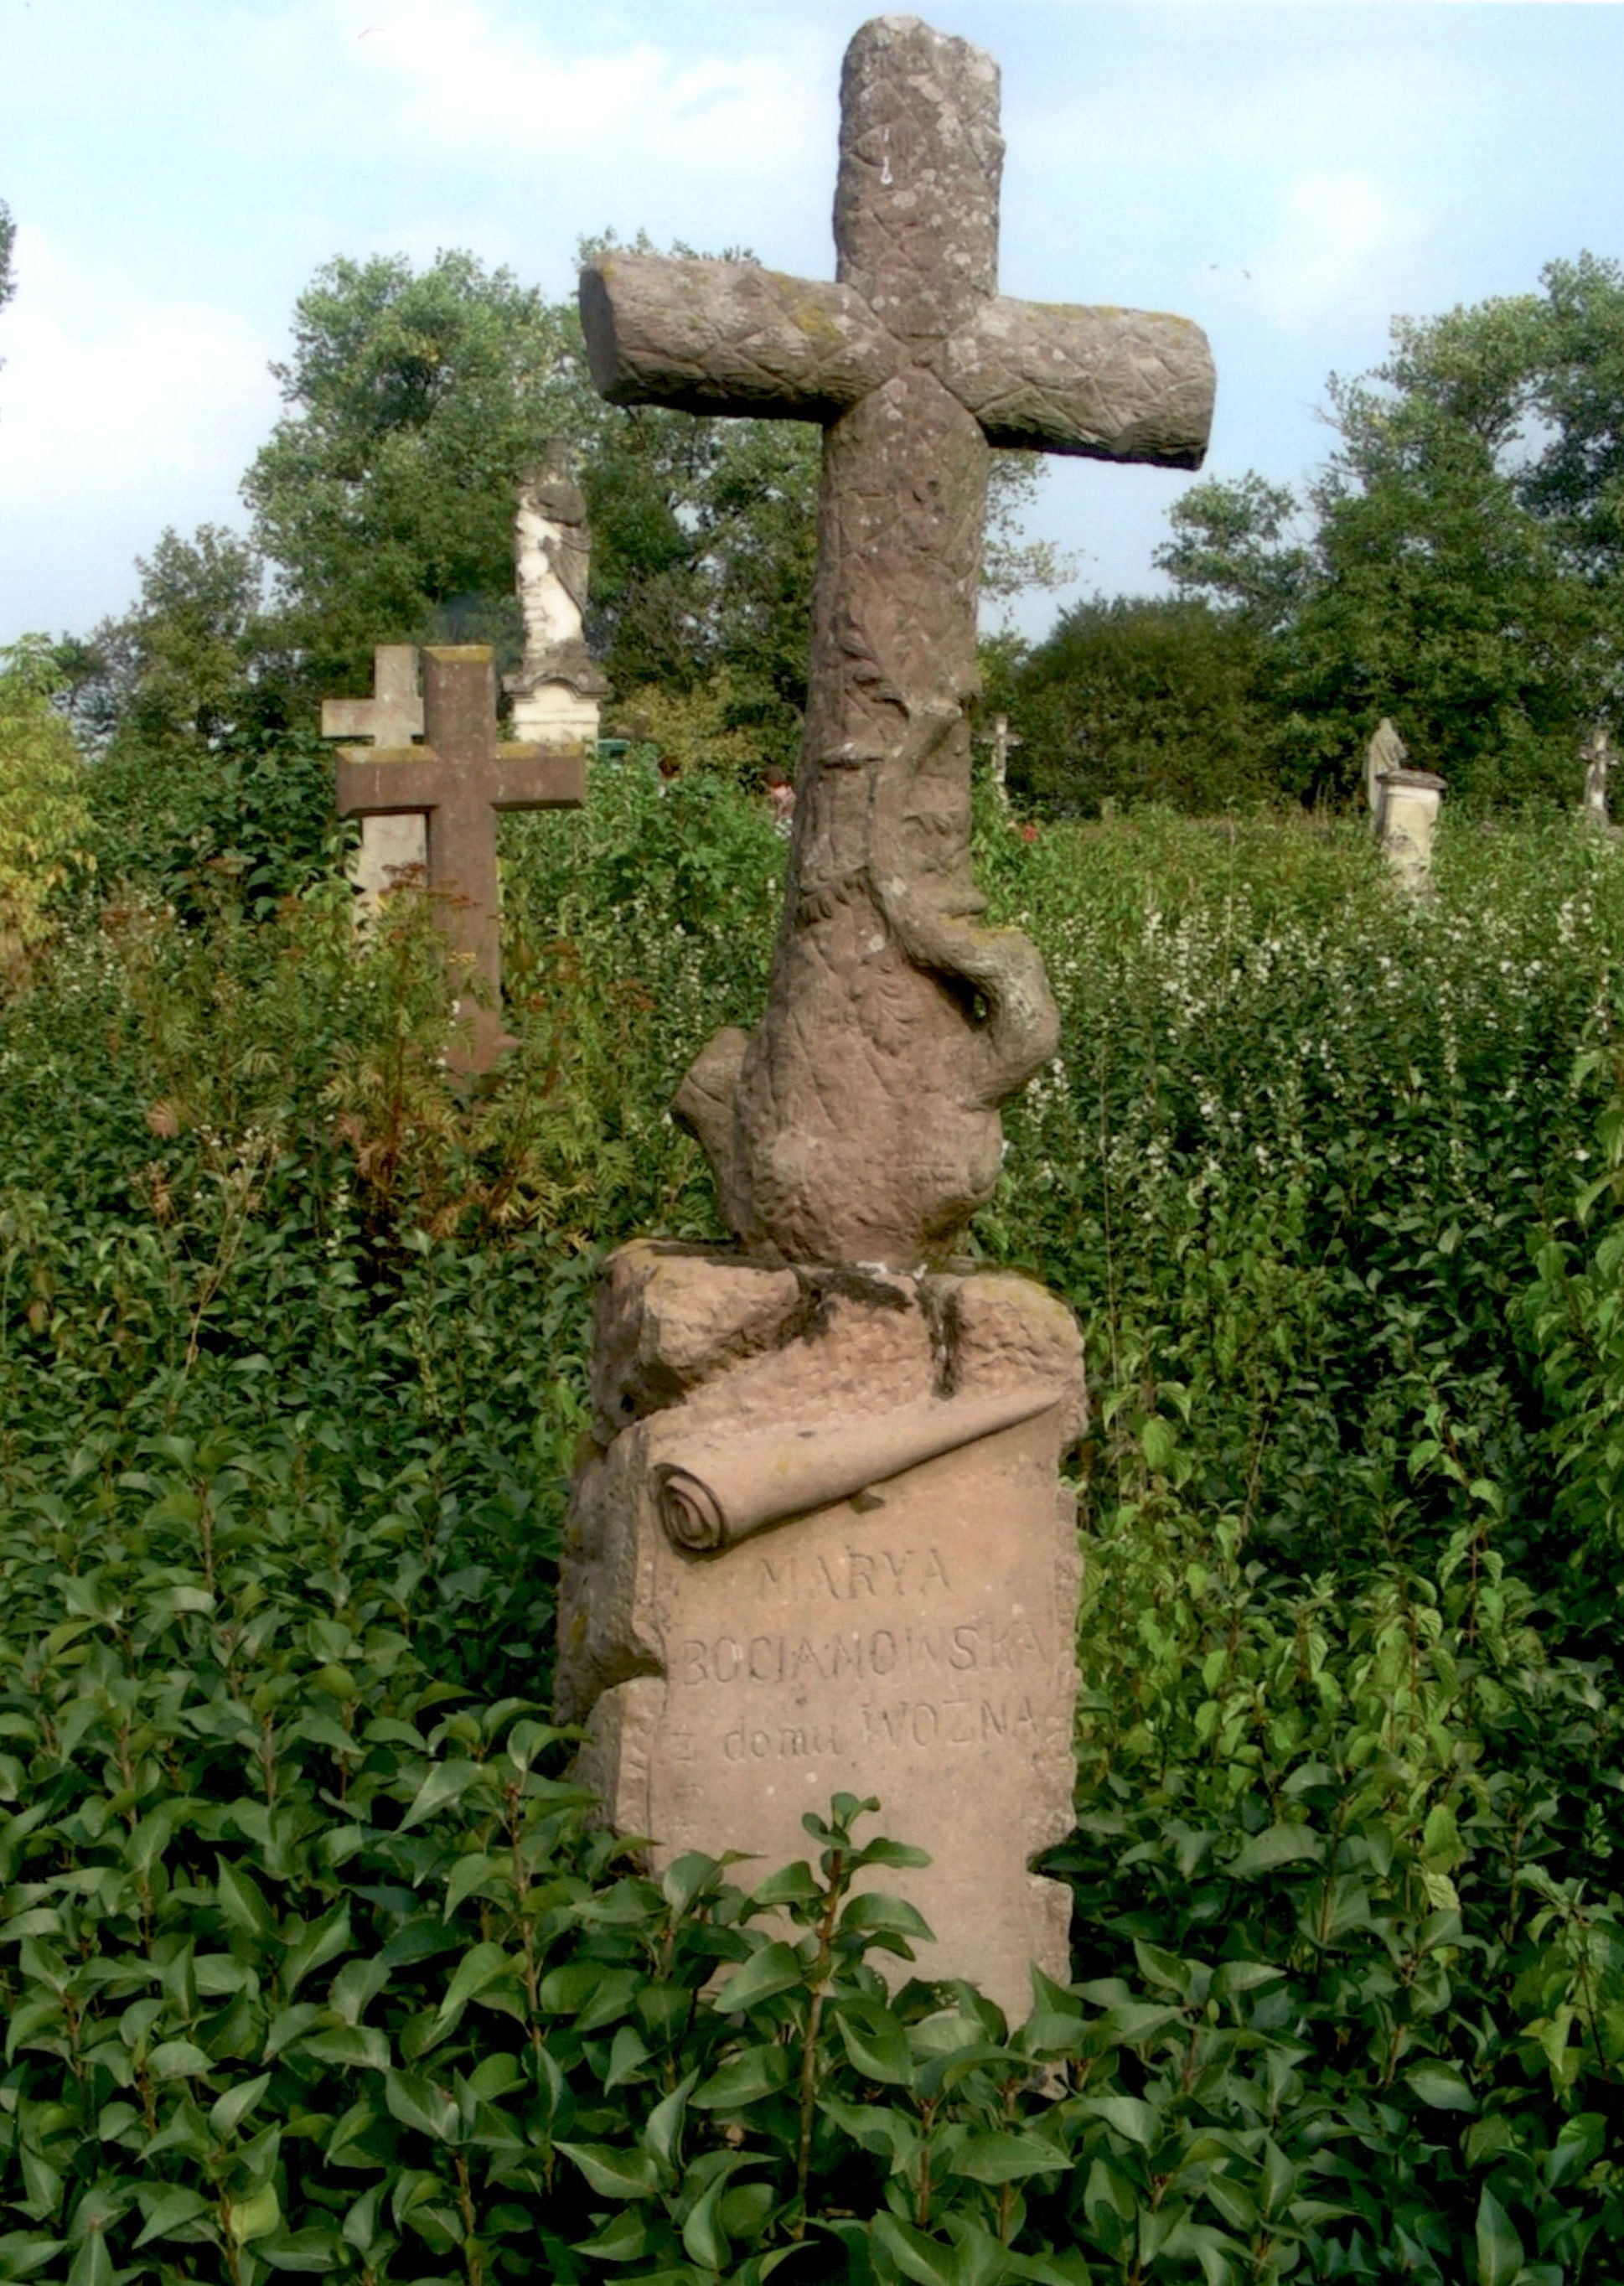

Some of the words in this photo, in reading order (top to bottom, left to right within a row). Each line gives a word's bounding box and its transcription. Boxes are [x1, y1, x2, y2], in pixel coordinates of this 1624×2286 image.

[758, 1544, 950, 1599] MARYA
[682, 1621, 1049, 1685] BOCIANOWSKA
[725, 1716, 845, 1761] domu
